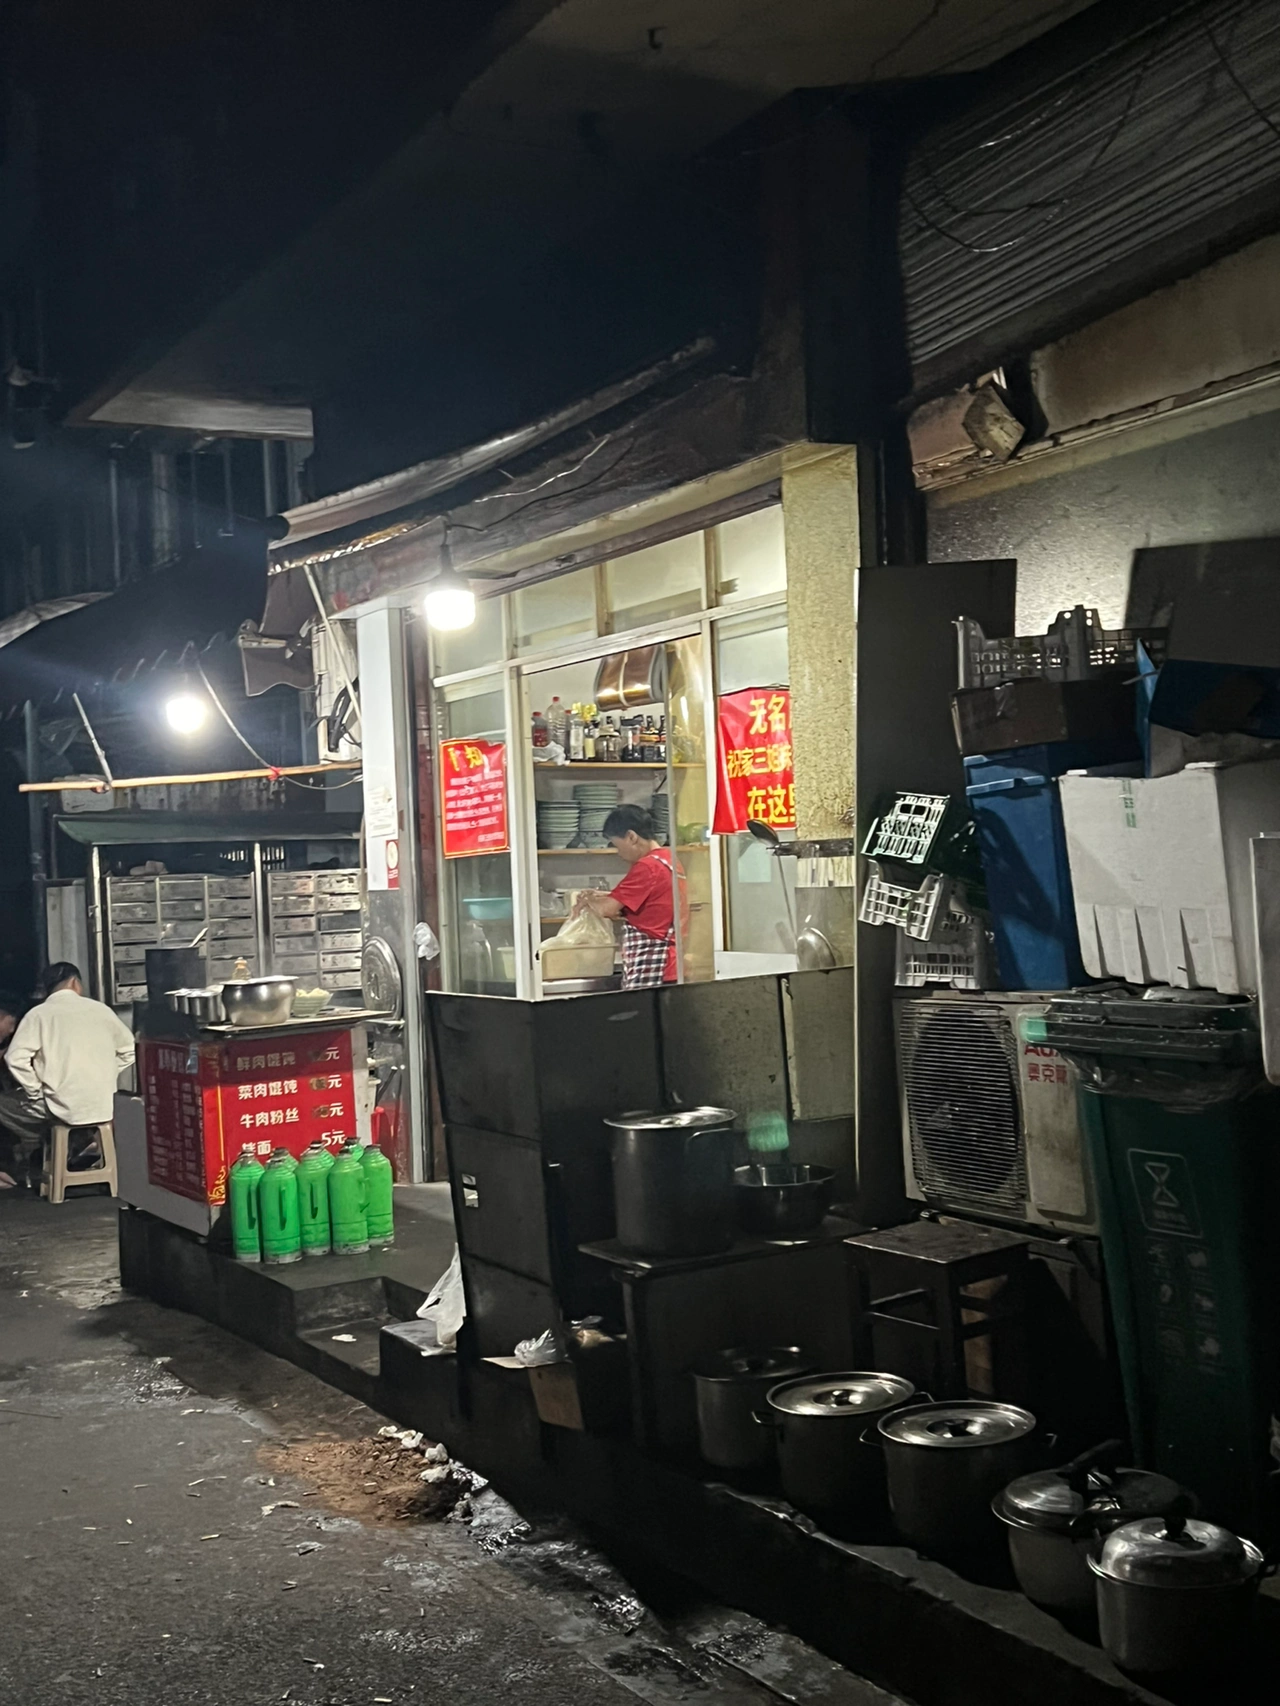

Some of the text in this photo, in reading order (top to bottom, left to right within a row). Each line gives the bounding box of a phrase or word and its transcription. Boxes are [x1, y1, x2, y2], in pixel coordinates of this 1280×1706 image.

[748, 693, 792, 735] 无名
[236, 1051, 296, 1071] 鲜肉馄饨
[1024, 1044, 1059, 1058] AU
[237, 1079, 298, 1100] 菜肉馄饨
[240, 1107, 300, 1129] 牛肉粉丝
[321, 1130, 346, 1147] 5元
